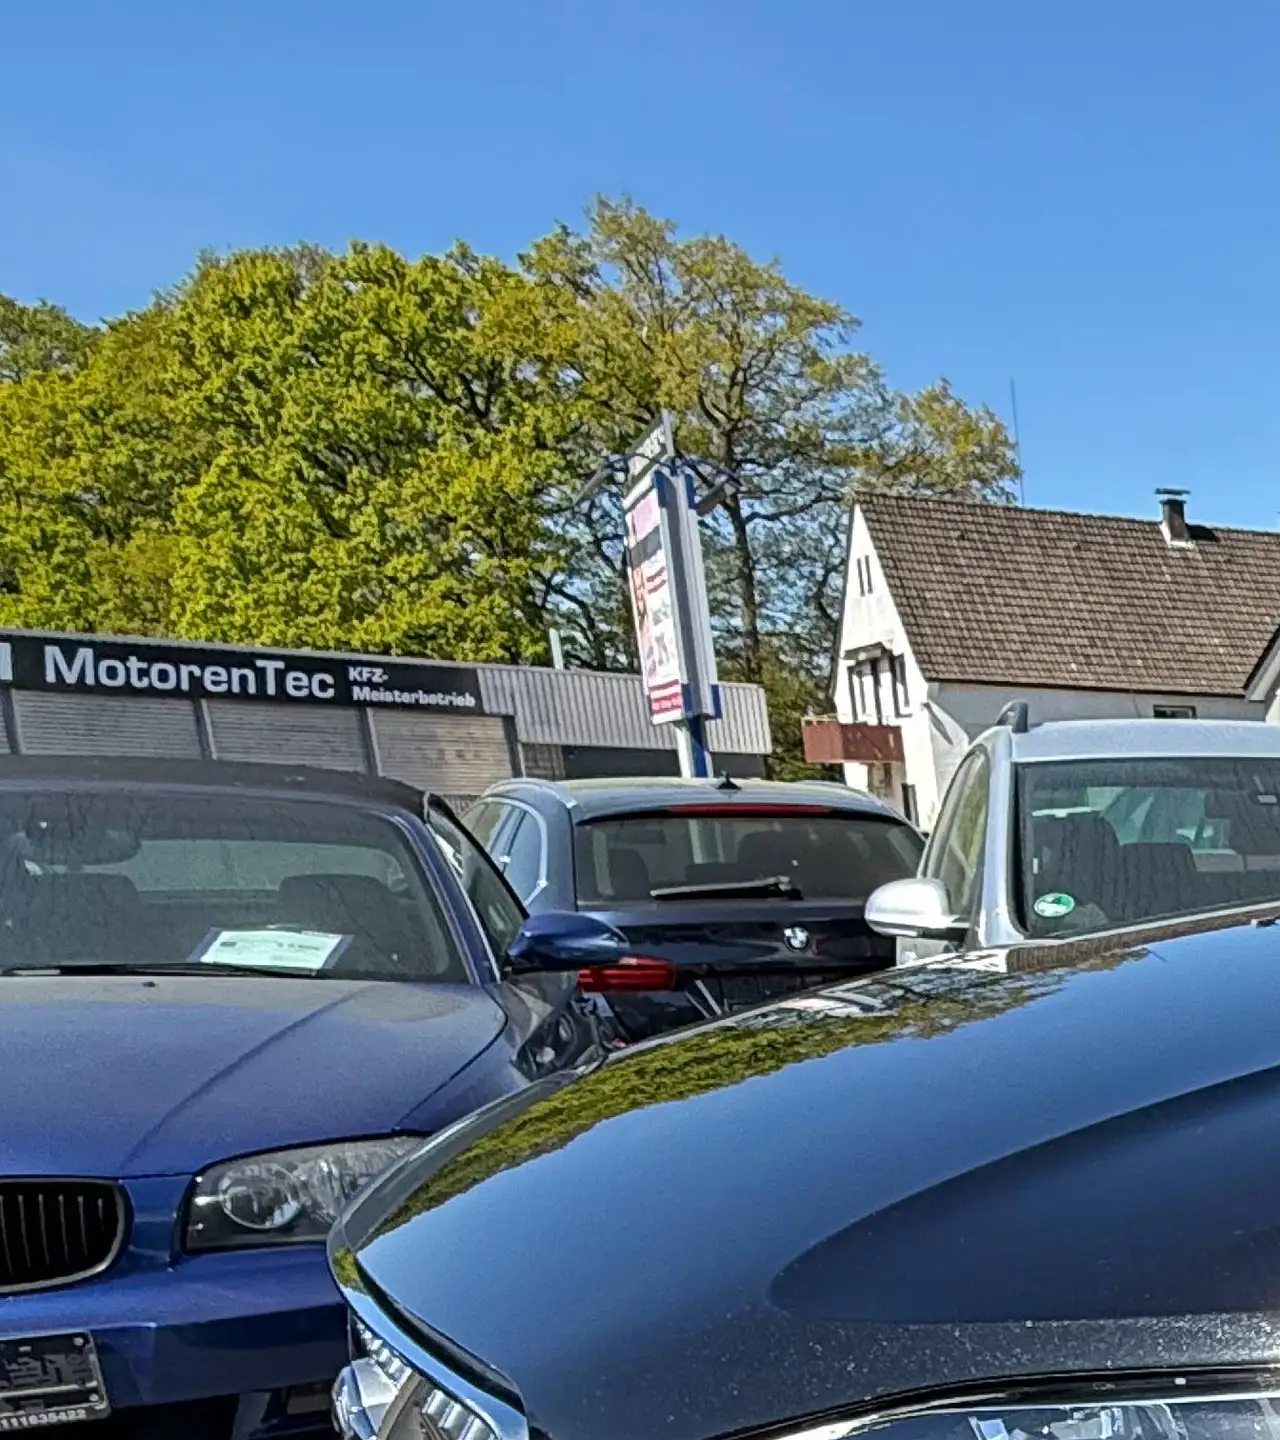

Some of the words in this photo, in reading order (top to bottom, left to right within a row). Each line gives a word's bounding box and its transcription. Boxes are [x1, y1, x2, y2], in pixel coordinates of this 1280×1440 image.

[44, 645, 336, 698] MotorenTec
[348, 666, 389, 683] KFZ-
[352, 685, 476, 707] Meisterbetrieb
